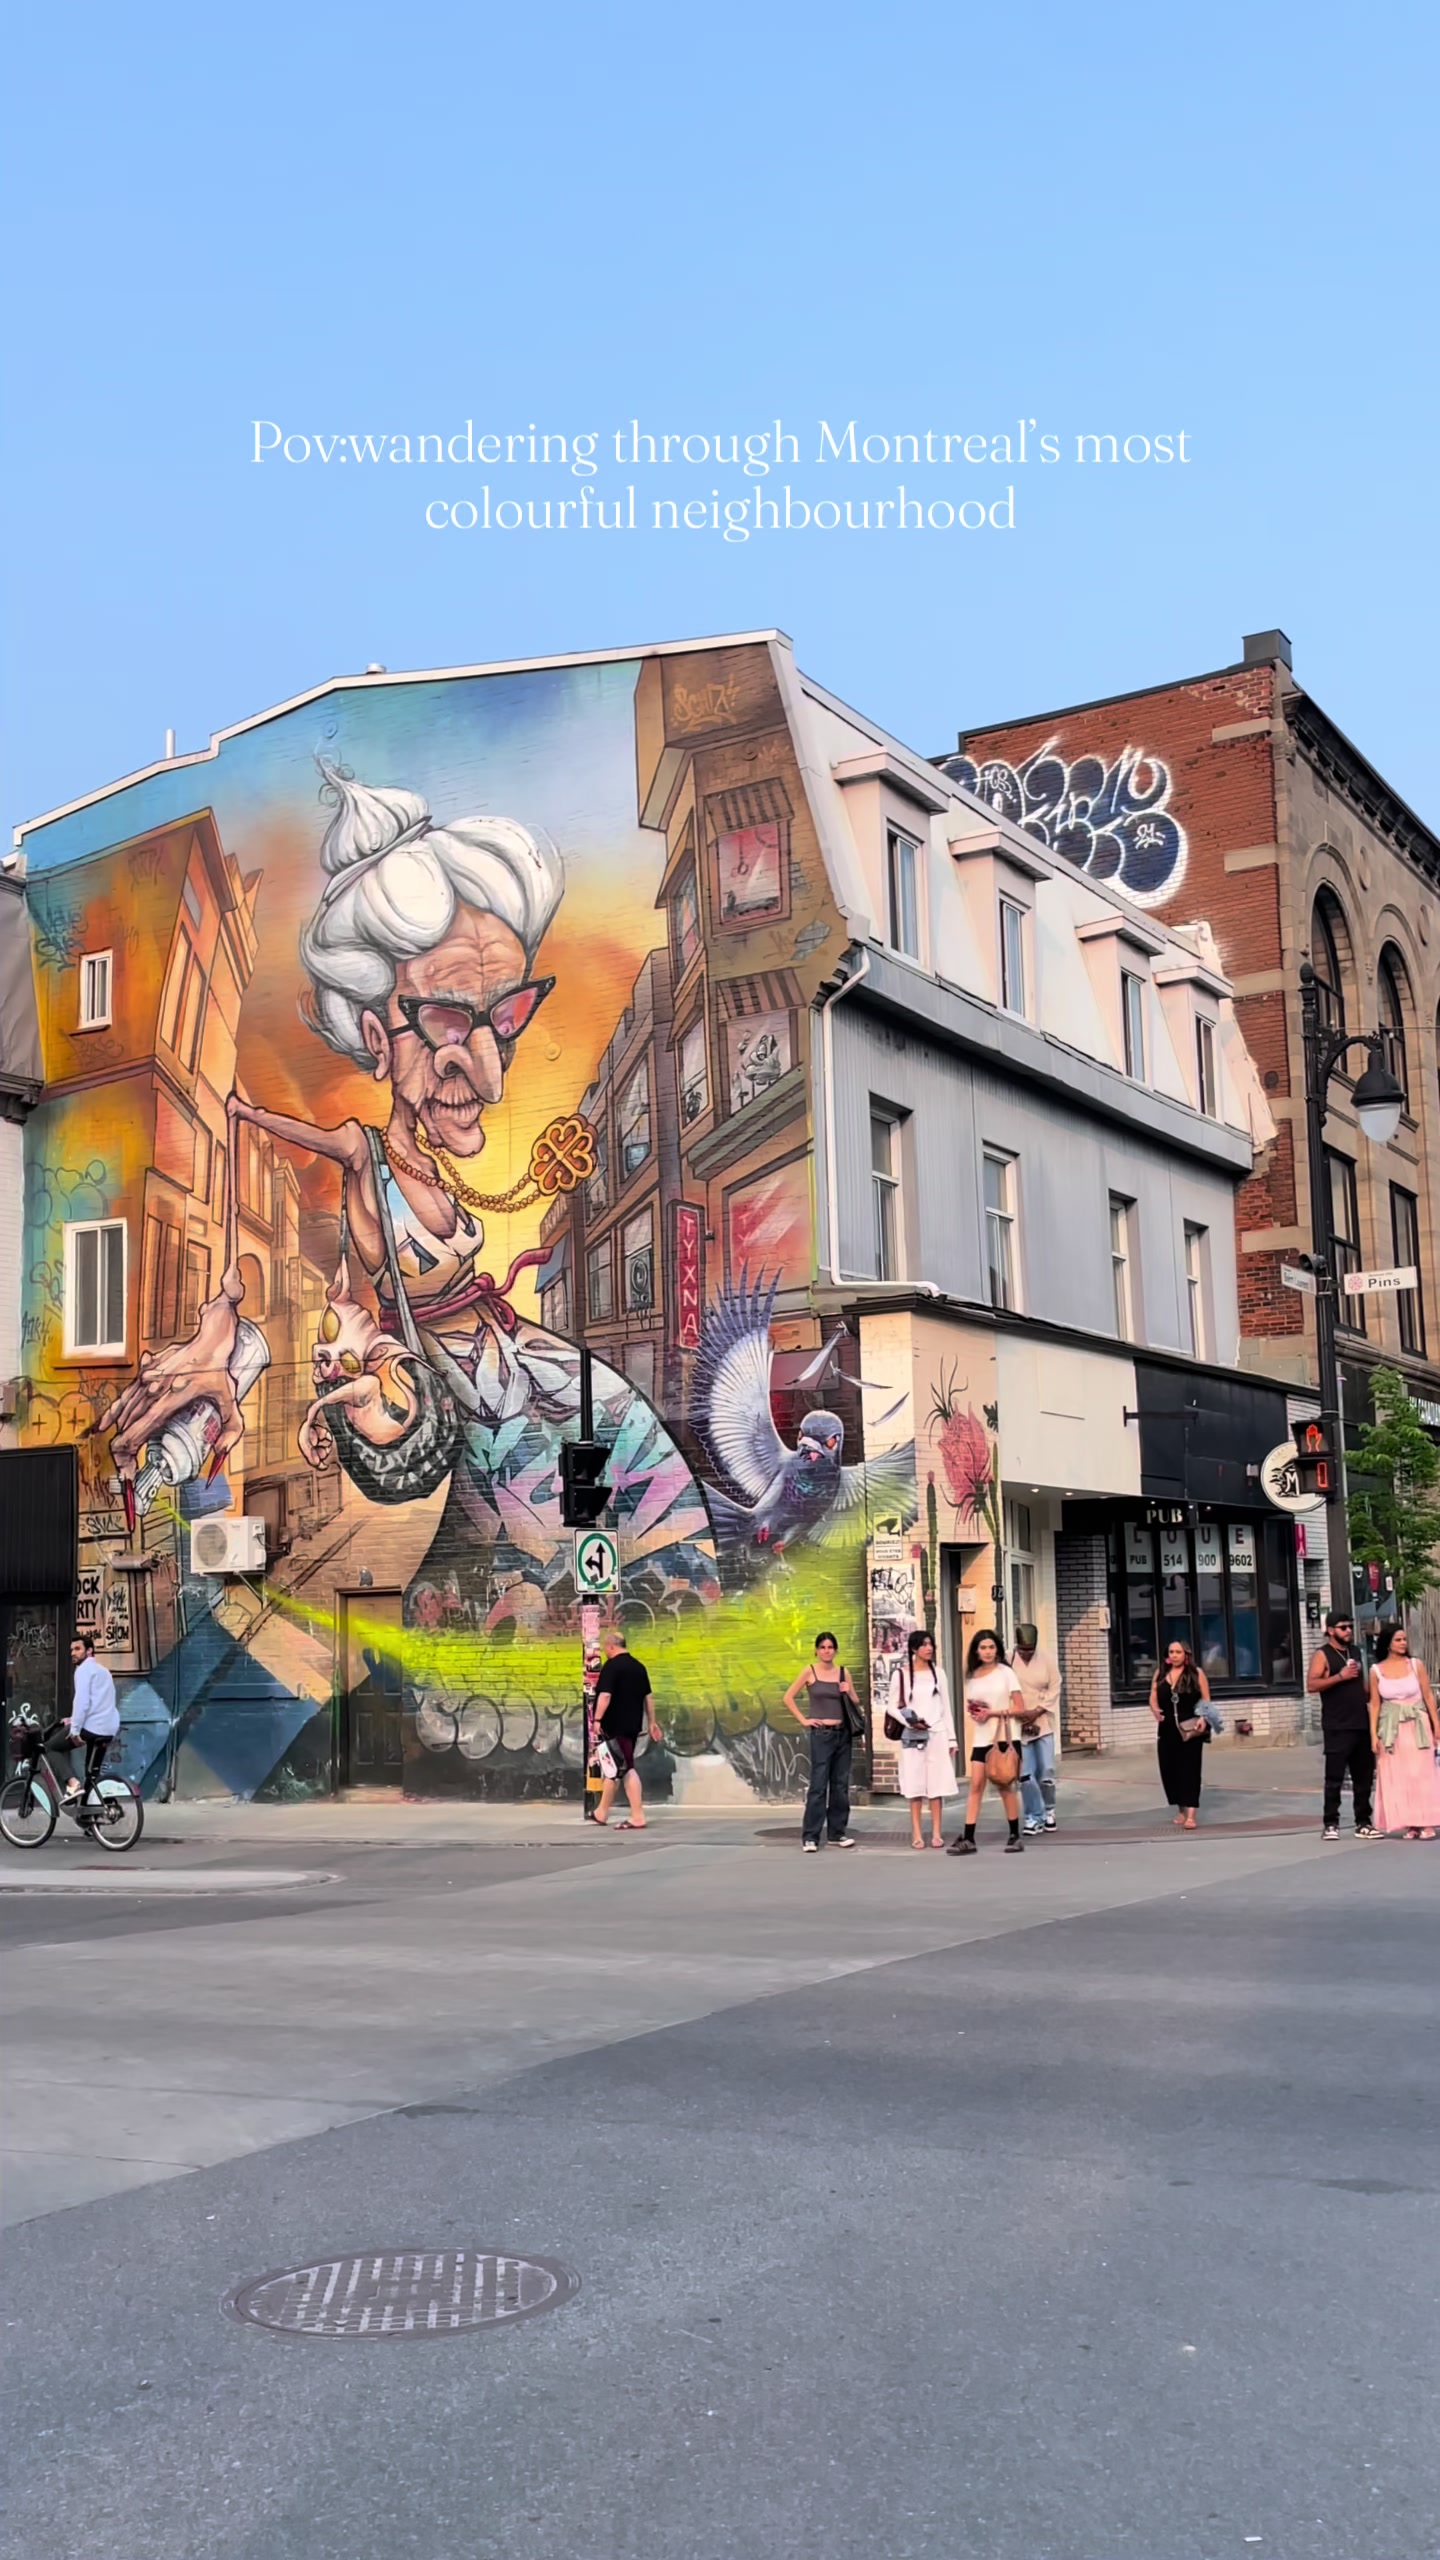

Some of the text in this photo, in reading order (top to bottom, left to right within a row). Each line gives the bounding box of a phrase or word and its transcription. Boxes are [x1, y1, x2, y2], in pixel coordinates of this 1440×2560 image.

[682, 1216, 698, 1335] TYXNA
[1368, 1277, 1401, 1288] Pins
[1146, 1508, 1183, 1524] PUB
[1129, 1555, 1147, 1565] PUB
[1163, 1554, 1182, 1567] 514
[1198, 1554, 1217, 1567] 900
[1229, 1554, 1253, 1567] 9602
